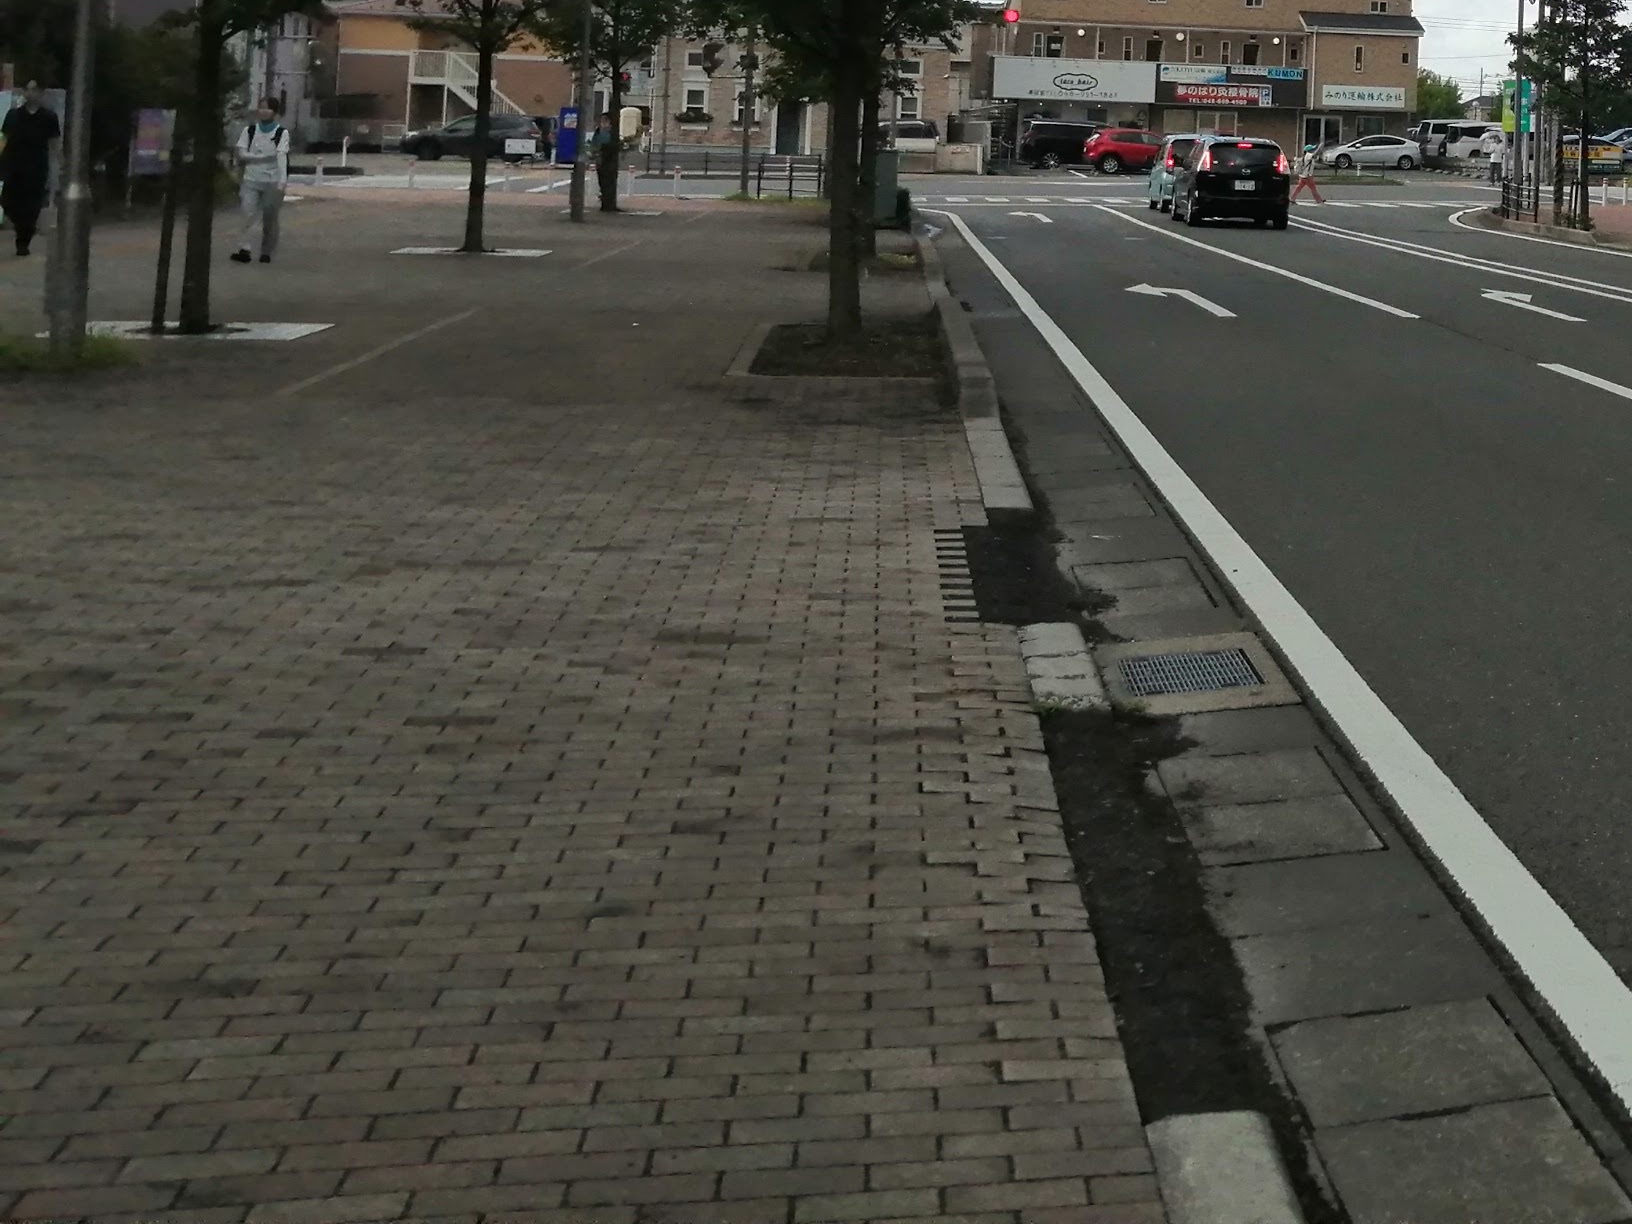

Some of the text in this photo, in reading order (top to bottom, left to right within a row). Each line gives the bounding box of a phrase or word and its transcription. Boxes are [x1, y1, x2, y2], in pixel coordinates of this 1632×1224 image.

[1267, 68, 1303, 78] KUMON
[1325, 91, 1403, 102] みのり運輸株式会社
